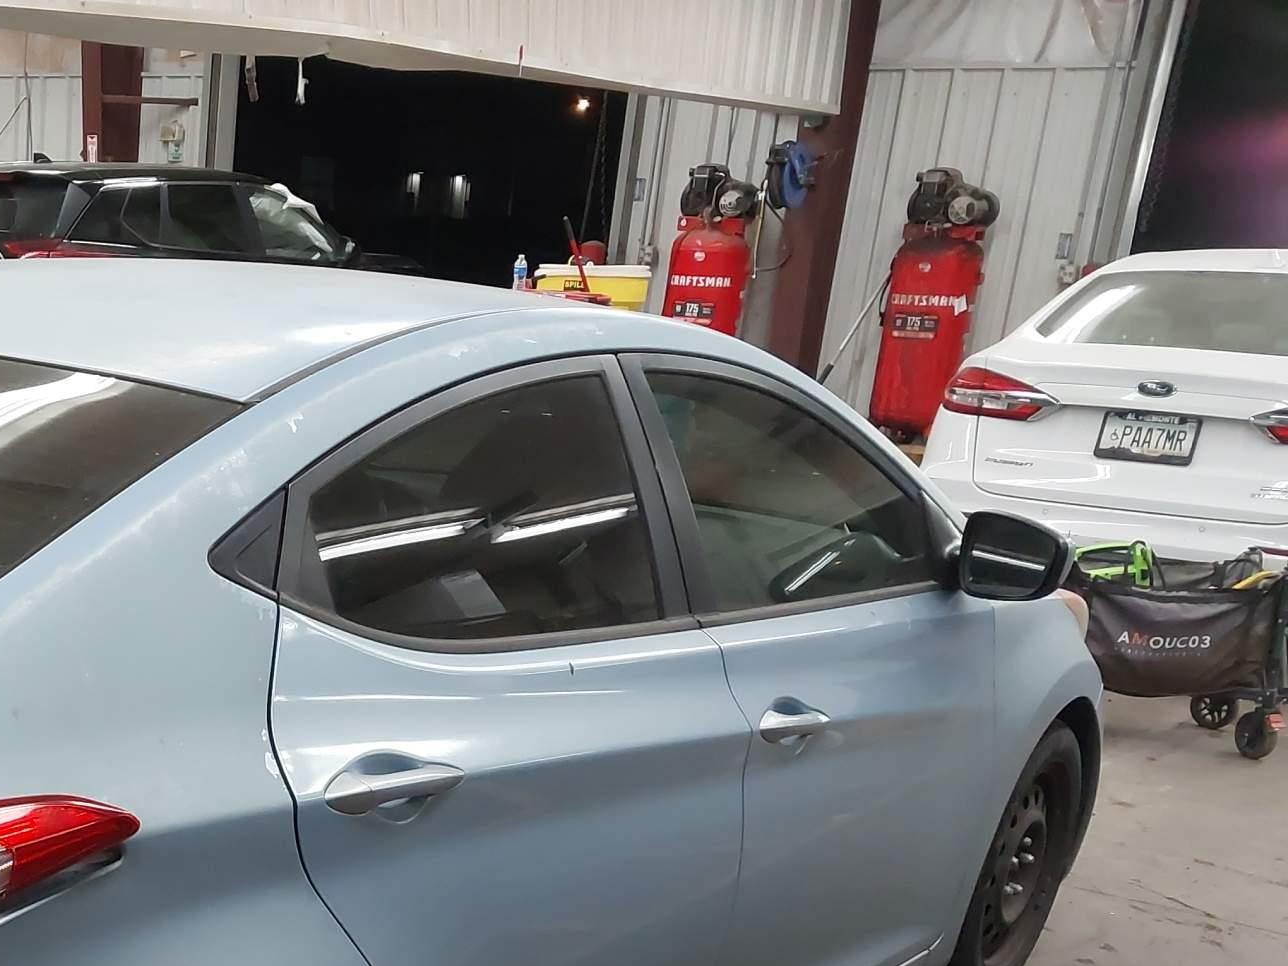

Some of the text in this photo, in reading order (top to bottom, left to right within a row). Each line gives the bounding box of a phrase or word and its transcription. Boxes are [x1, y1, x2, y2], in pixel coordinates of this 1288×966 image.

[671, 275, 731, 287] CRAFTSMAN
[686, 303, 700, 313] 175
[907, 316, 922, 327] 175
[1120, 426, 1188, 451] PAA7MR
